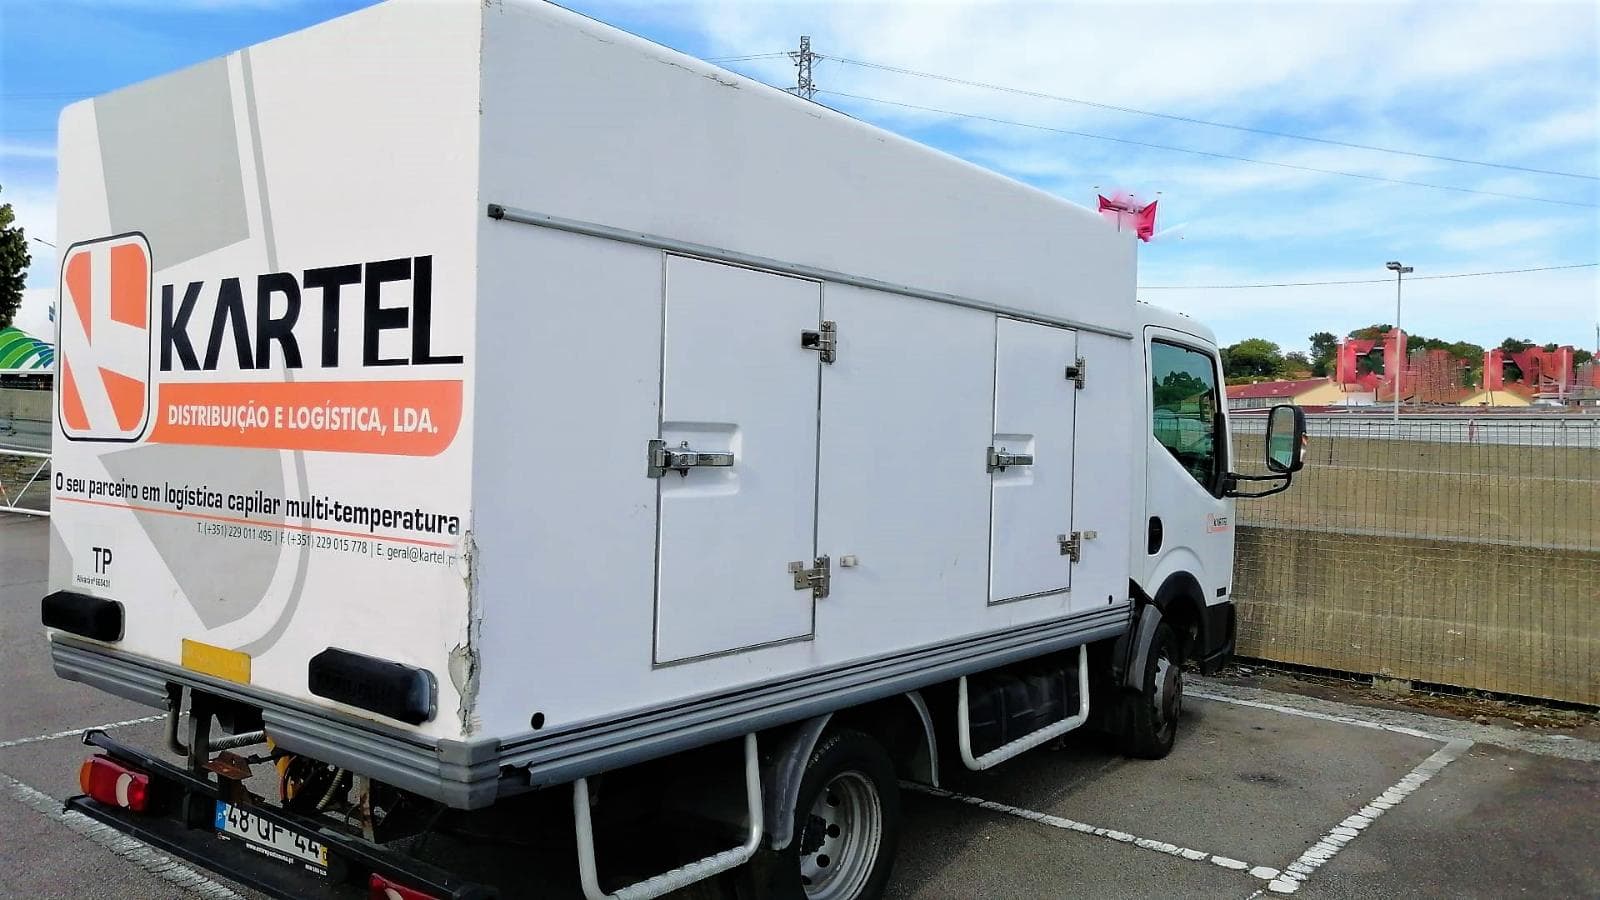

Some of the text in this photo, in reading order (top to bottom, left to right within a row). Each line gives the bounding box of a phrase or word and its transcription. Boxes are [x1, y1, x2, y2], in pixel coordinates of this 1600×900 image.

[160, 254, 464, 371] KARTEL
[167, 400, 439, 436] DISTRIBUIÇÃO E LOGÍSTICA, LDA.
[55, 472, 461, 535] O seu parceiro em logística capilar multi-temperatura
[92, 546, 112, 574] TP
[228, 526, 242, 538] 229
[243, 527, 257, 540] 011
[257, 529, 272, 542] 495
[316, 536, 332, 549] 229
[333, 538, 349, 551] 015
[351, 540, 368, 554] 778
[387, 546, 456, 567] geral@kartel.p
